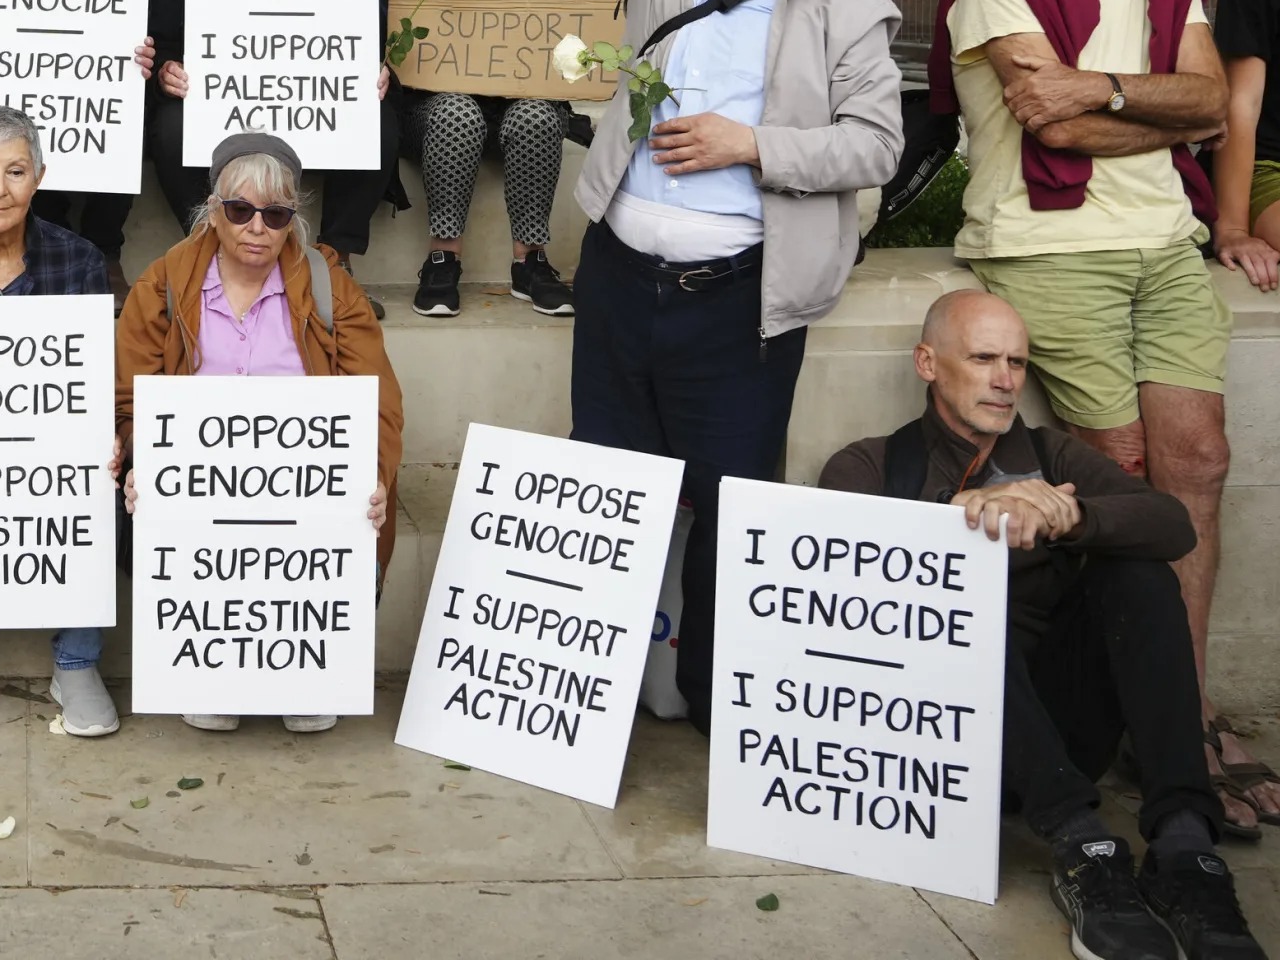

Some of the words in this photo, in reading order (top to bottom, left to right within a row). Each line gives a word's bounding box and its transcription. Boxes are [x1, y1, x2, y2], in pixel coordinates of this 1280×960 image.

[201, 33, 217, 59] I
[231, 34, 363, 61] SUPPORT
[437, 10, 594, 44] SUPPORT
[204, 73, 359, 102] PALESTINE
[224, 105, 336, 132] ACTION
[153, 414, 175, 447] I
[199, 415, 351, 448] OPPOSE
[155, 464, 348, 497] GENOCIDE
[476, 462, 500, 495] I
[515, 472, 646, 524] OPPOSE
[152, 547, 176, 580] I
[194, 548, 352, 581] SUPPORT
[471, 512, 634, 572] GENOCIDE
[745, 529, 766, 565] I
[792, 535, 966, 591] OPPOSE
[157, 598, 350, 632] PALESTINE
[444, 586, 464, 619] I
[473, 594, 627, 656] SUPPORT
[749, 585, 973, 647] GENOCIDE
[172, 637, 326, 670] ACTION
[437, 638, 612, 712] PALESTINE
[444, 683, 580, 746] ACTION
[732, 672, 754, 707] I
[776, 679, 975, 742] SUPPORT
[740, 729, 969, 802] PALESTINE
[762, 777, 935, 839] ACTION
